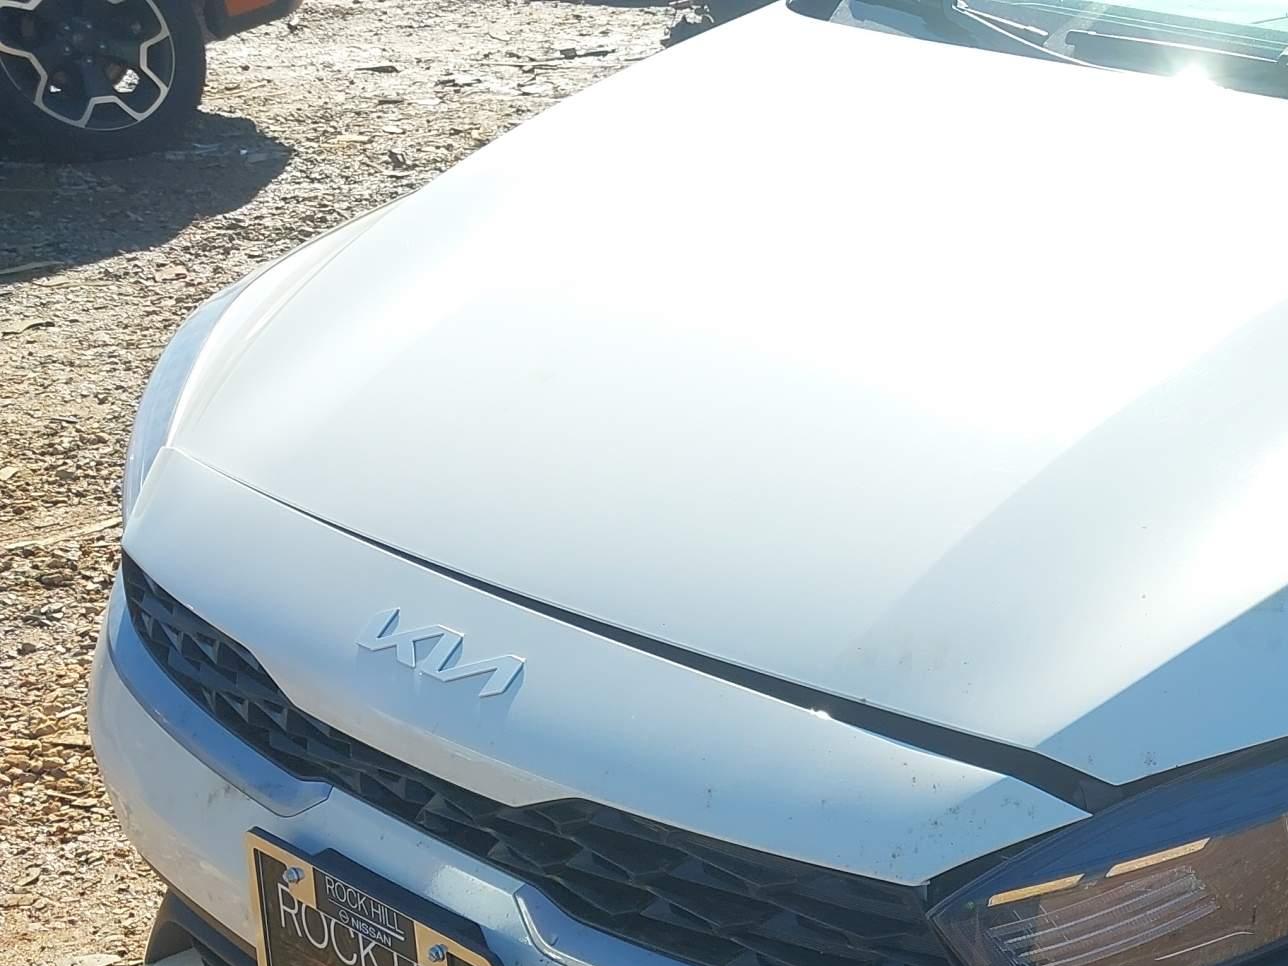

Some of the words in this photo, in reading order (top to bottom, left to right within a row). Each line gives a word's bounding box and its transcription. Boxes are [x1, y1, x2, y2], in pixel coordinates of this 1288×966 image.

[325, 875, 368, 916] ROCK
[370, 899, 404, 934] HILL
[351, 917, 392, 947] NISSAN
